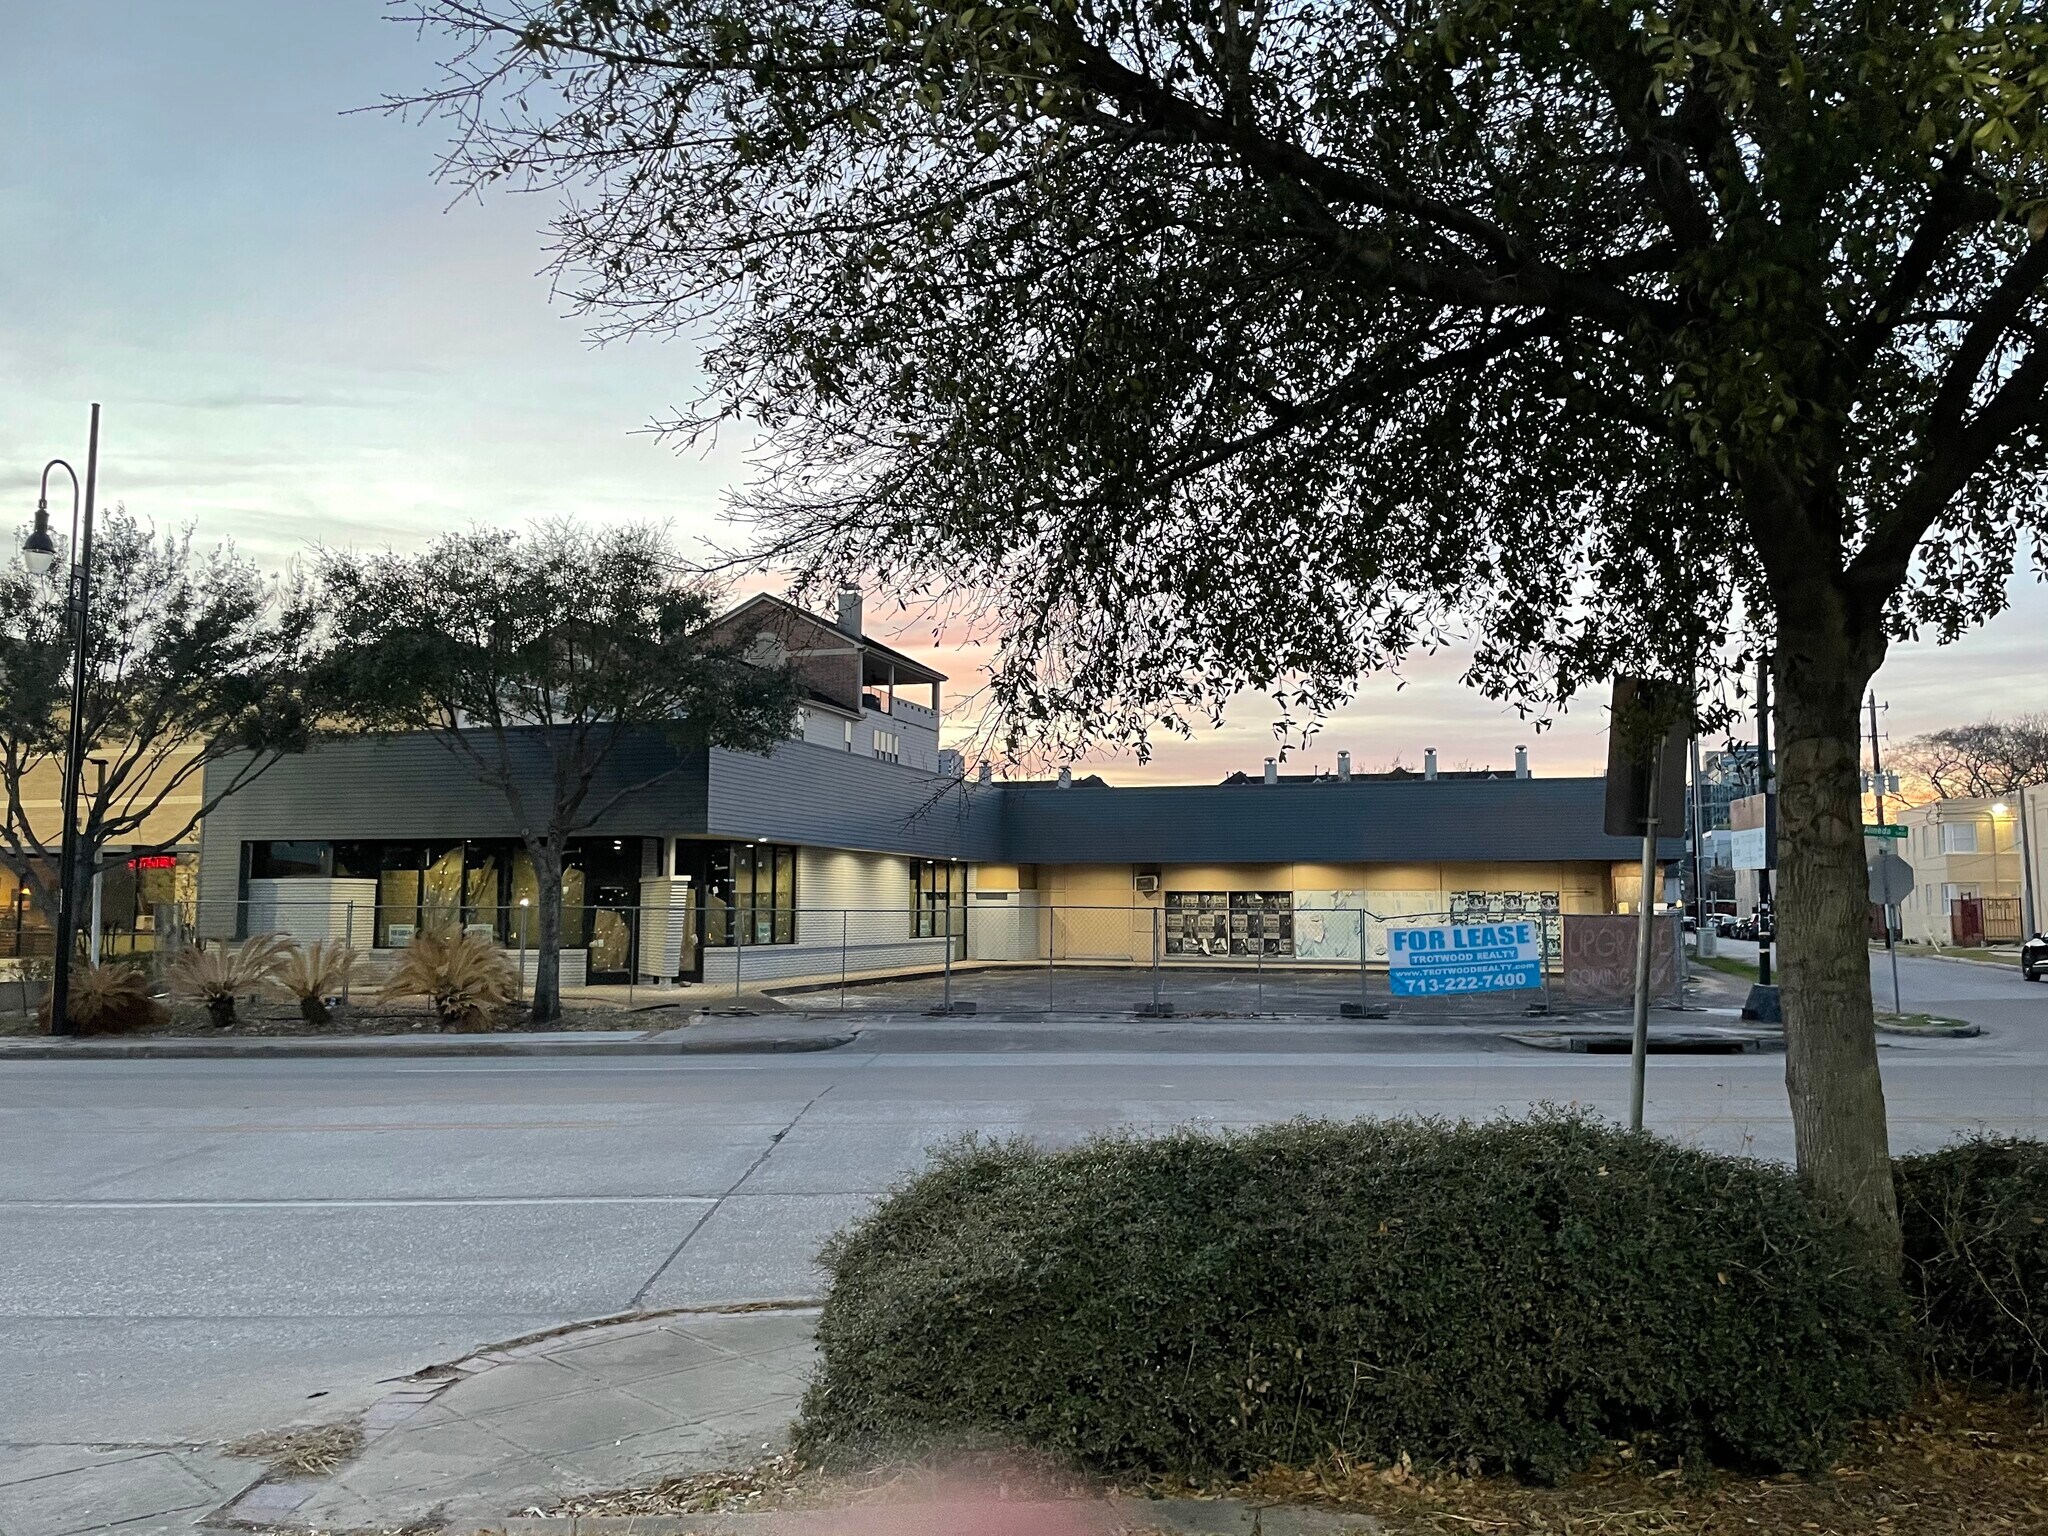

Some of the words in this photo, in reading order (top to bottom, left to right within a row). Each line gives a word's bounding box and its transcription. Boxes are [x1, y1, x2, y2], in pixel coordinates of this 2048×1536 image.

[1394, 930, 1446, 951] FOR
[1453, 925, 1530, 949] LEASE
[1568, 927, 1670, 957] UPGRAE
[1411, 953, 1473, 964] TROTWOOD
[1477, 949, 1516, 960] REALTY
[1395, 963, 1535, 977] www.TROTWOODREALTY.com
[1570, 968, 1630, 986] COMING
[1405, 972, 1527, 993] 713-222-7400
